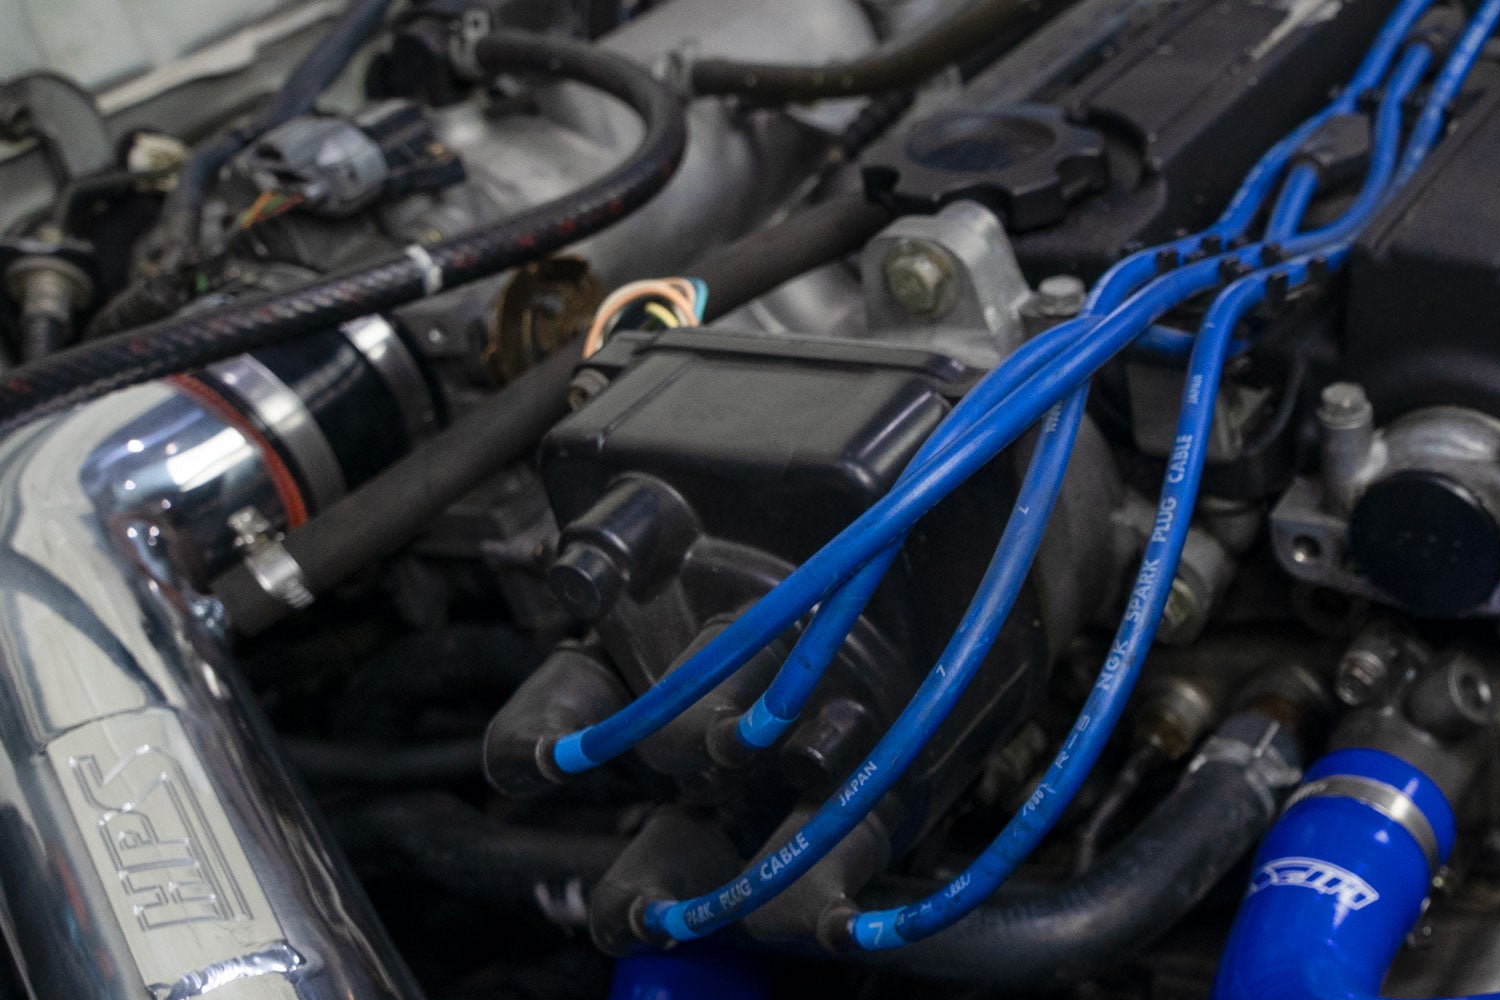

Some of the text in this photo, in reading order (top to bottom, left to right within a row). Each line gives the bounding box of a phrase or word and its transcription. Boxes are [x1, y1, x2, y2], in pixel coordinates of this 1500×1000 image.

[1097, 639, 1128, 690] NGK
[1126, 558, 1159, 622] SPARK
[1152, 498, 1177, 542] PLUG
[1167, 434, 1192, 484] CABLE
[68, 743, 255, 932] HPS
[686, 760, 878, 927] PARK PLUG CABLE JAPAN
